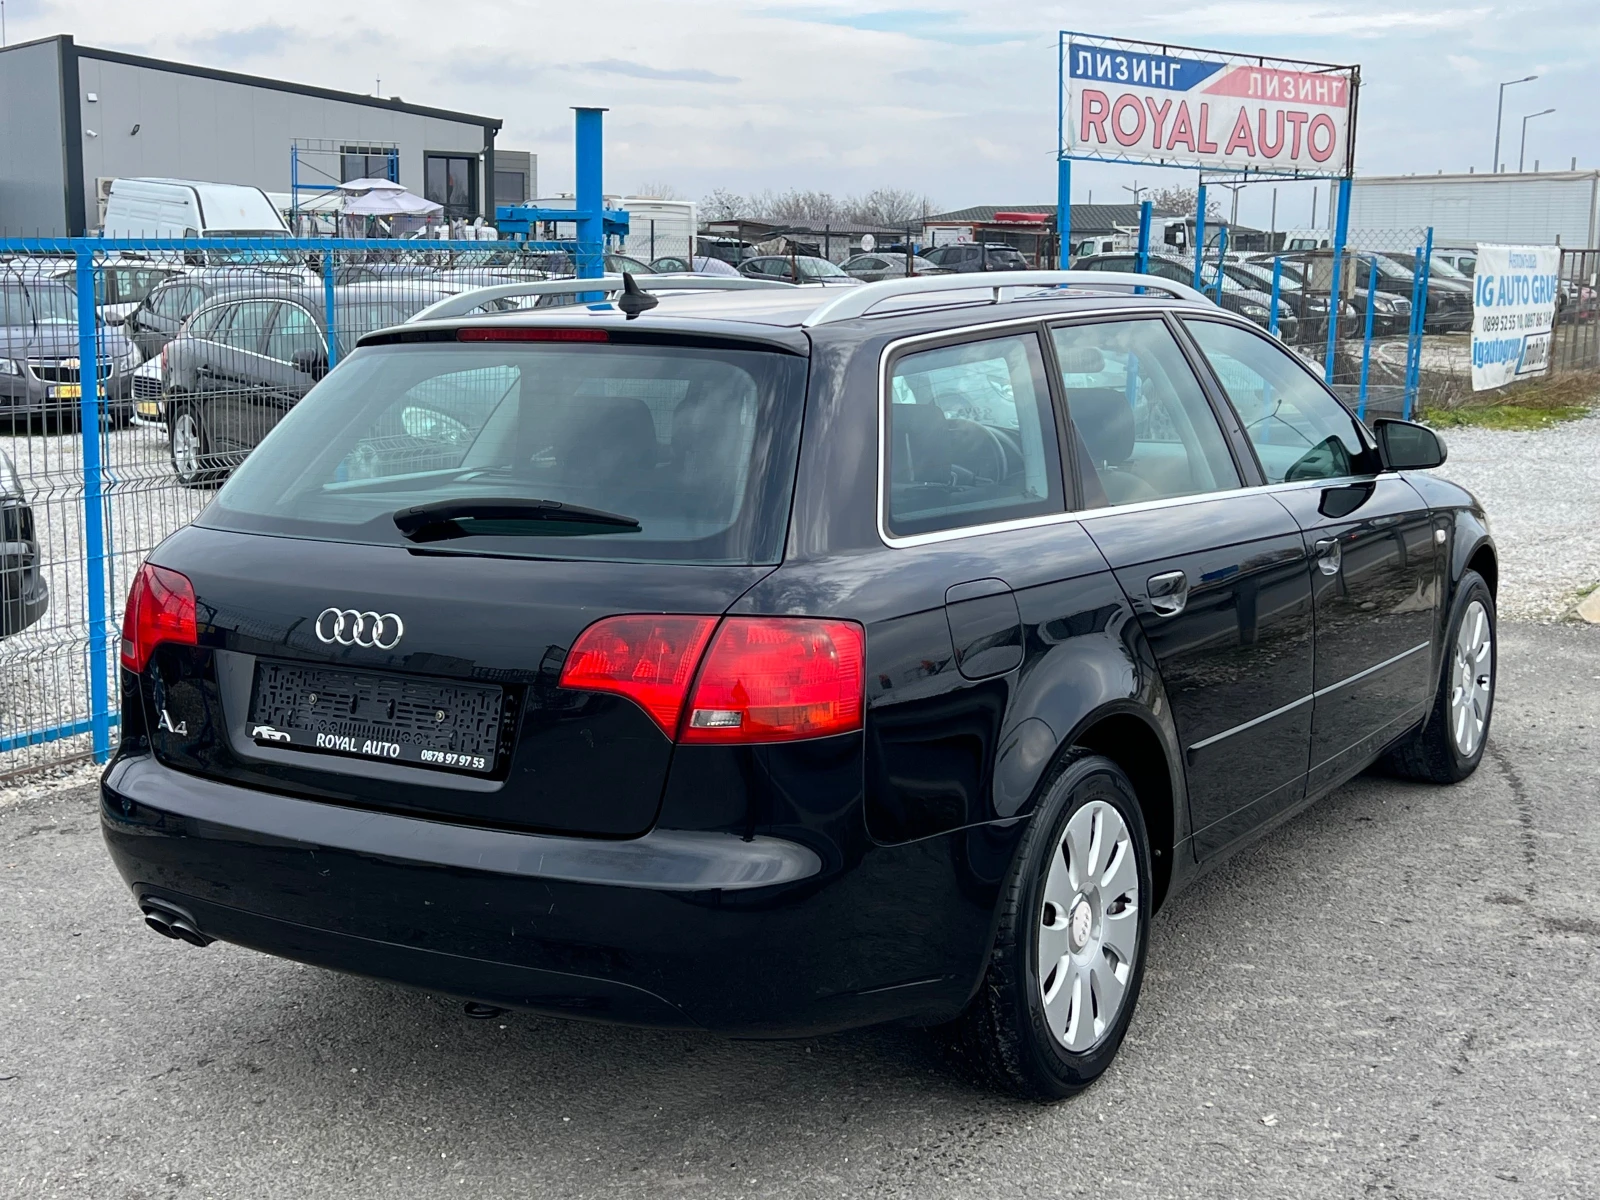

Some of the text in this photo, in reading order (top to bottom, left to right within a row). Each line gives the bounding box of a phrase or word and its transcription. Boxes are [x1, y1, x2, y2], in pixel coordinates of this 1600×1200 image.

[1076, 51, 1181, 87] ЛИЗИНГ
[1248, 72, 1342, 103] ЛИЗИНГ
[1080, 89, 1336, 163] ROYAL AUTO
[1476, 275, 1494, 308] IG
[1496, 275, 1530, 307] AUTO
[1483, 316, 1499, 332] 0899
[1509, 314, 1516, 330] 55
[158, 710, 188, 737] A4
[316, 733, 400, 758] ROYAL AUTO
[421, 749, 485, 769] 0878 97 97 53
